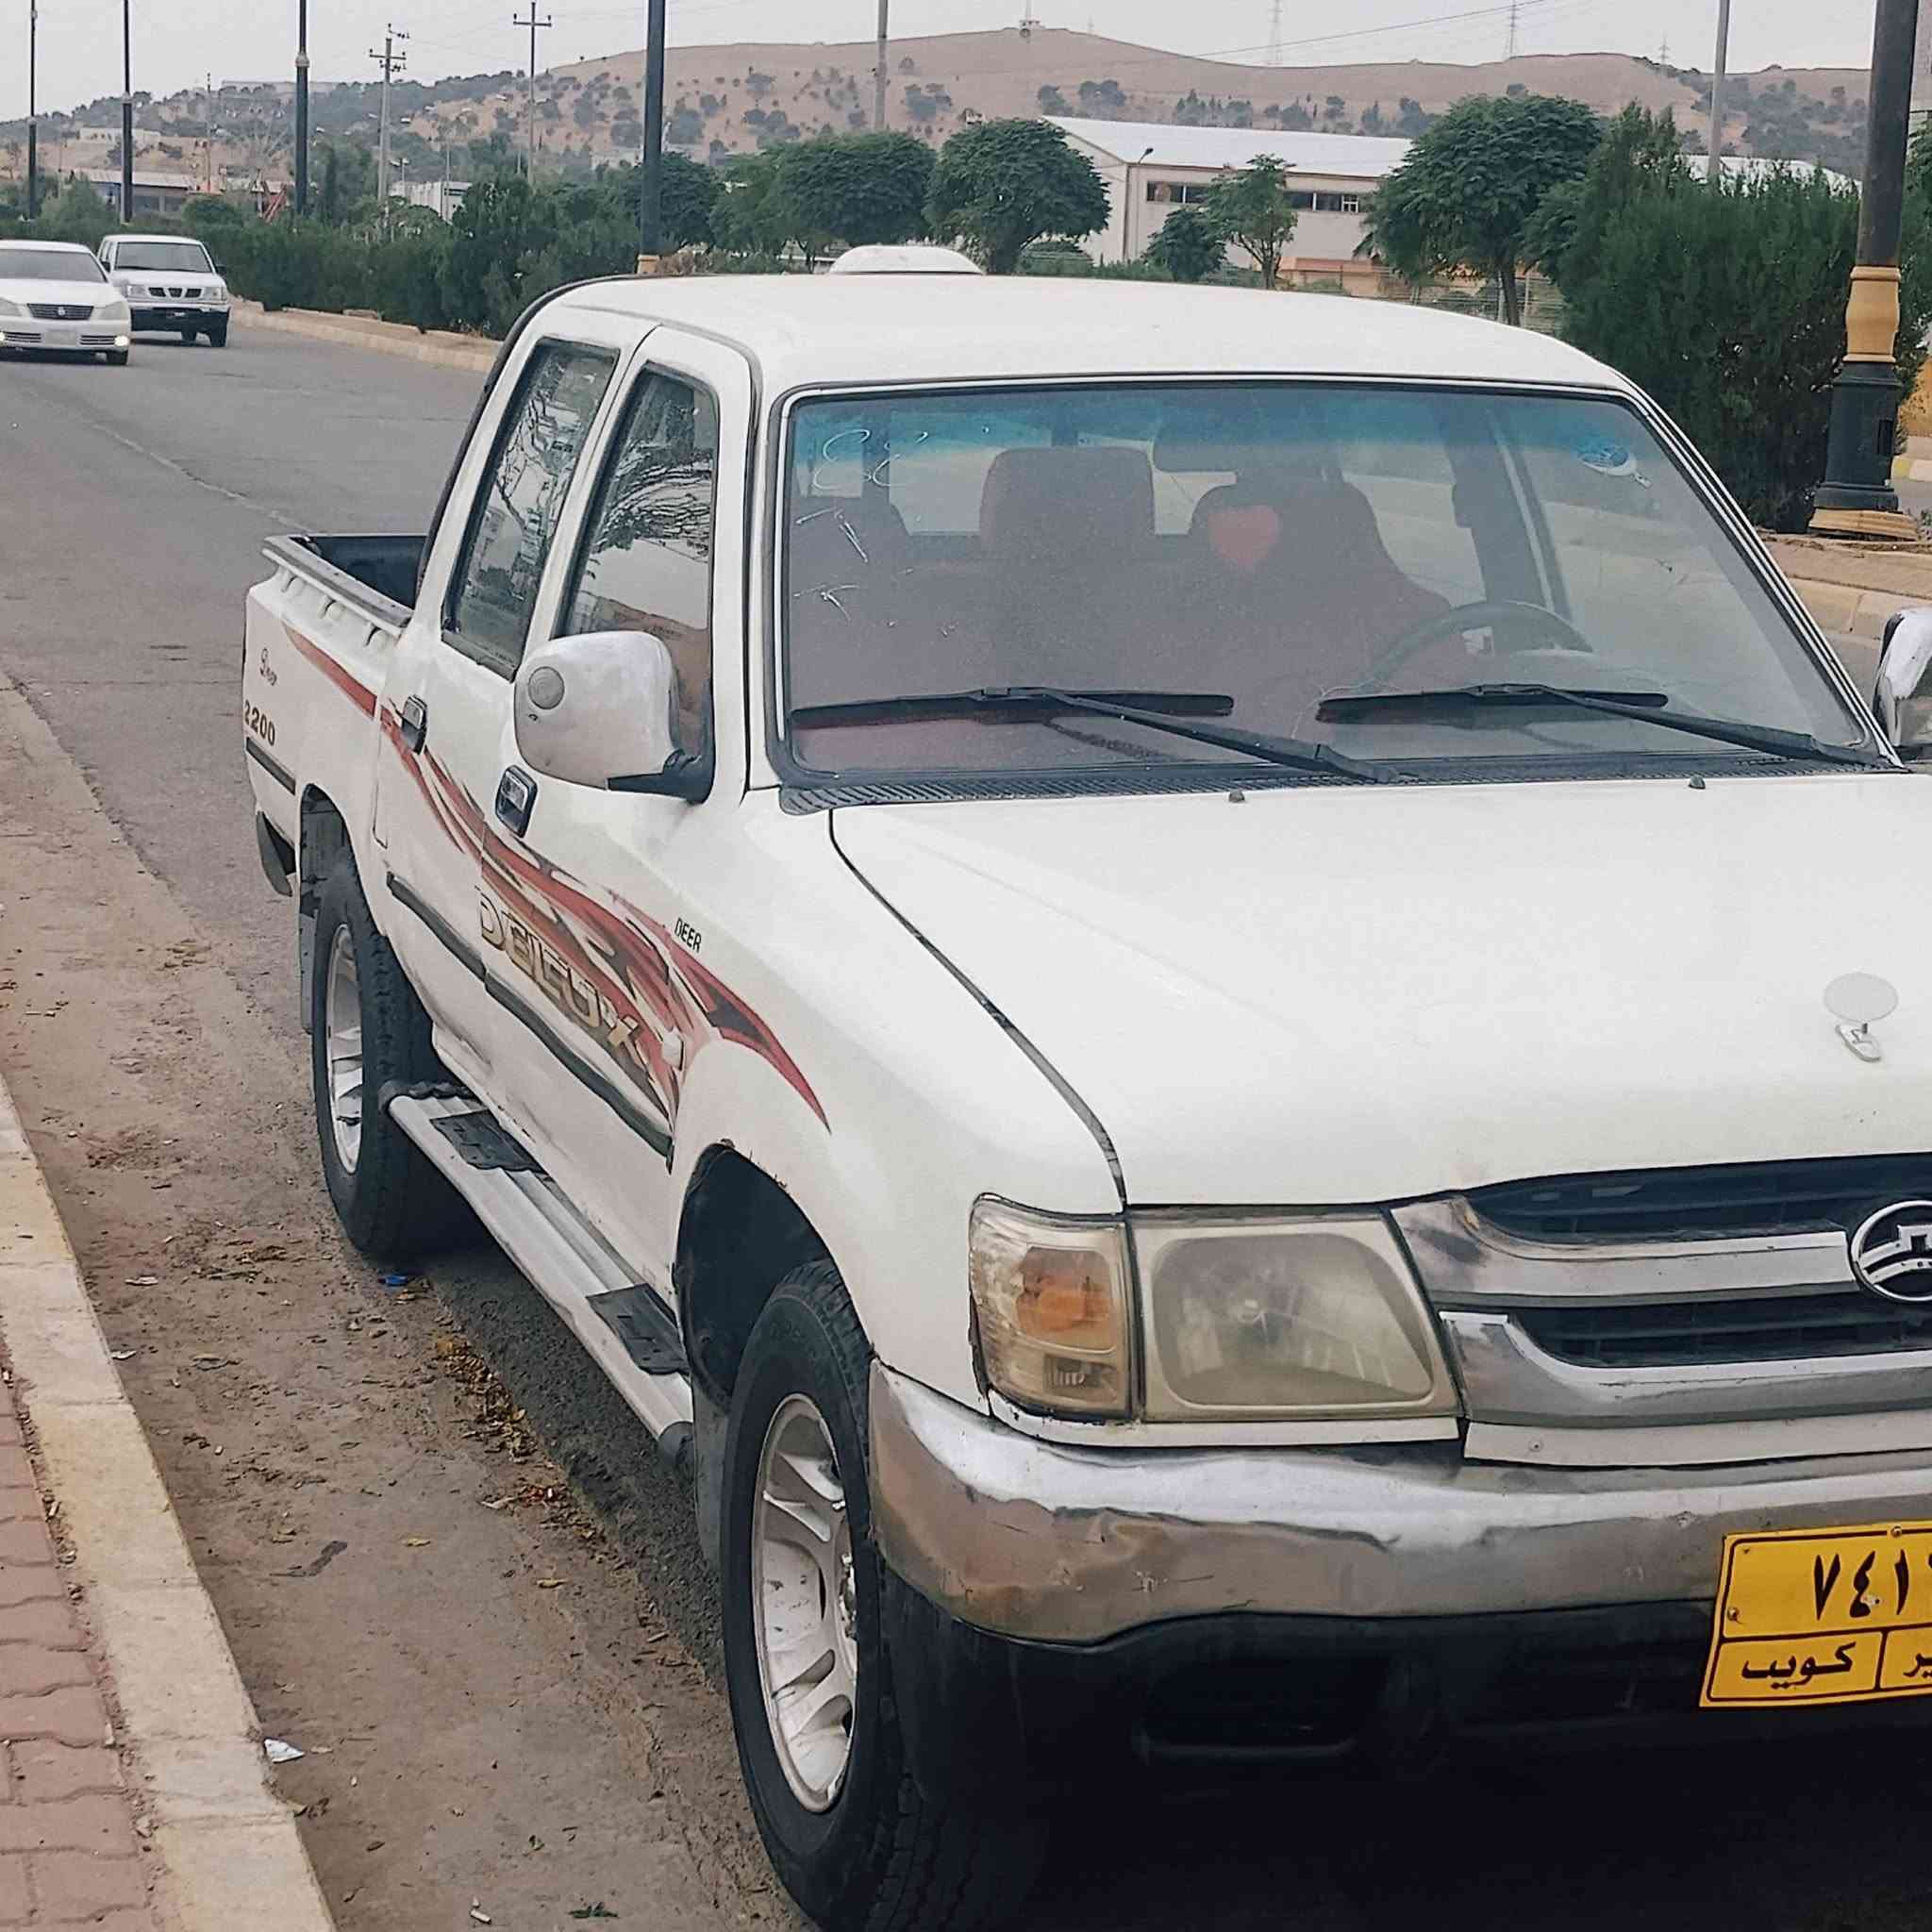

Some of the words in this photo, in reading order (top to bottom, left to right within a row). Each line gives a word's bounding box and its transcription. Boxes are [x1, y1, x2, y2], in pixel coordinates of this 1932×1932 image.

[244, 699, 275, 746] 2200
[675, 917, 702, 953] DEER
[1813, 1548, 1932, 1621] ٧٤١
